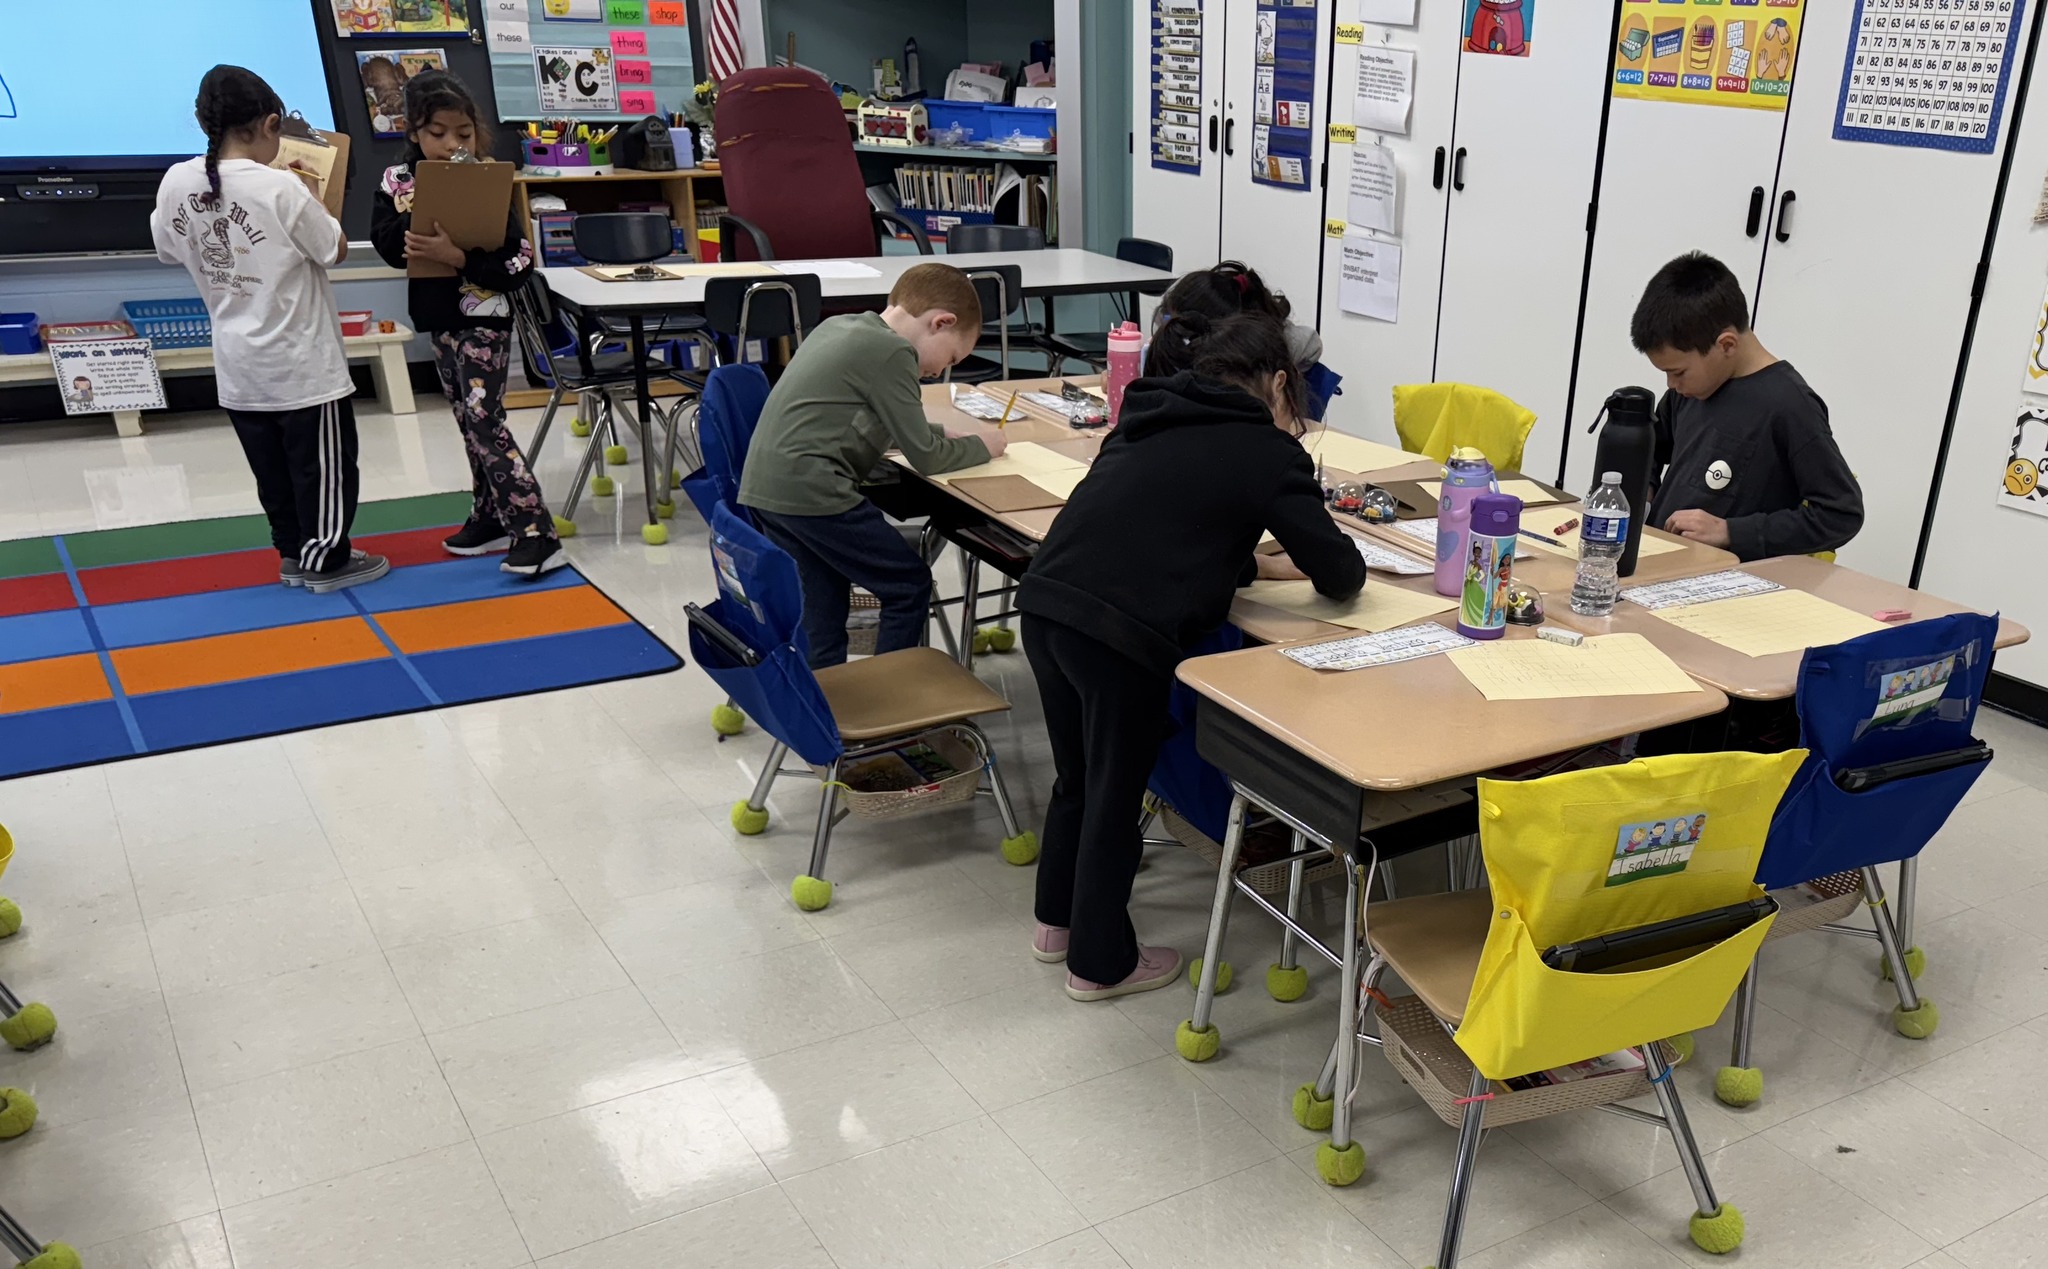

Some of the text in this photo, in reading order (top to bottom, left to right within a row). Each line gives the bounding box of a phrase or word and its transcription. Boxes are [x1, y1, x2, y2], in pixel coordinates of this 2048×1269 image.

[499, 2, 514, 10] our
[1880, 0, 1890, 8] 52
[1894, 0, 1904, 8] 53
[1909, 0, 1919, 8] 54
[1924, 0, 1934, 9] 55
[1938, 0, 1949, 10] 56
[1954, 0, 1964, 10] 57
[1968, 1, 1979, 11] 58
[1984, 1, 1994, 11] 59
[1999, 2, 2011, 12] 60
[613, 8, 640, 20] these
[655, 8, 678, 22] shop
[1863, 17, 2006, 32] 61 62 63 64 65 66 67 68 69 70
[497, 33, 522, 43] these
[1336, 26, 1362, 42] Reading
[617, 36, 643, 50] thing
[1861, 36, 2002, 53] 71 72 73 74 75 76 77 78 79 80
[1857, 56, 1997, 73] 81 82 83 84 85 86 87 88 89 90
[538, 55, 599, 97] K C
[619, 64, 644, 80] bring
[1649, 73, 1676, 84] 7+7=14
[1682, 75, 1710, 87] 8+8=16
[1718, 78, 1746, 90] 9+9=18
[1751, 80, 1789, 93] 10+10=20
[1853, 75, 1994, 93] 91 92 93 94 95 96 97 98 99 100
[626, 98, 645, 110] sing
[1176, 95, 1194, 106] SNACK
[1849, 94, 1989, 113] 101 102 103 104 105 106 107 108 109 110
[1846, 113, 1986, 133] 111 112 113 114 115 116 117 118 119 120
[1329, 127, 1355, 141] Writing
[227, 201, 268, 246] Wall
[1326, 223, 1344, 235] Math
[58, 349, 87, 360] Work
[1616, 847, 1682, 875] Isabella
